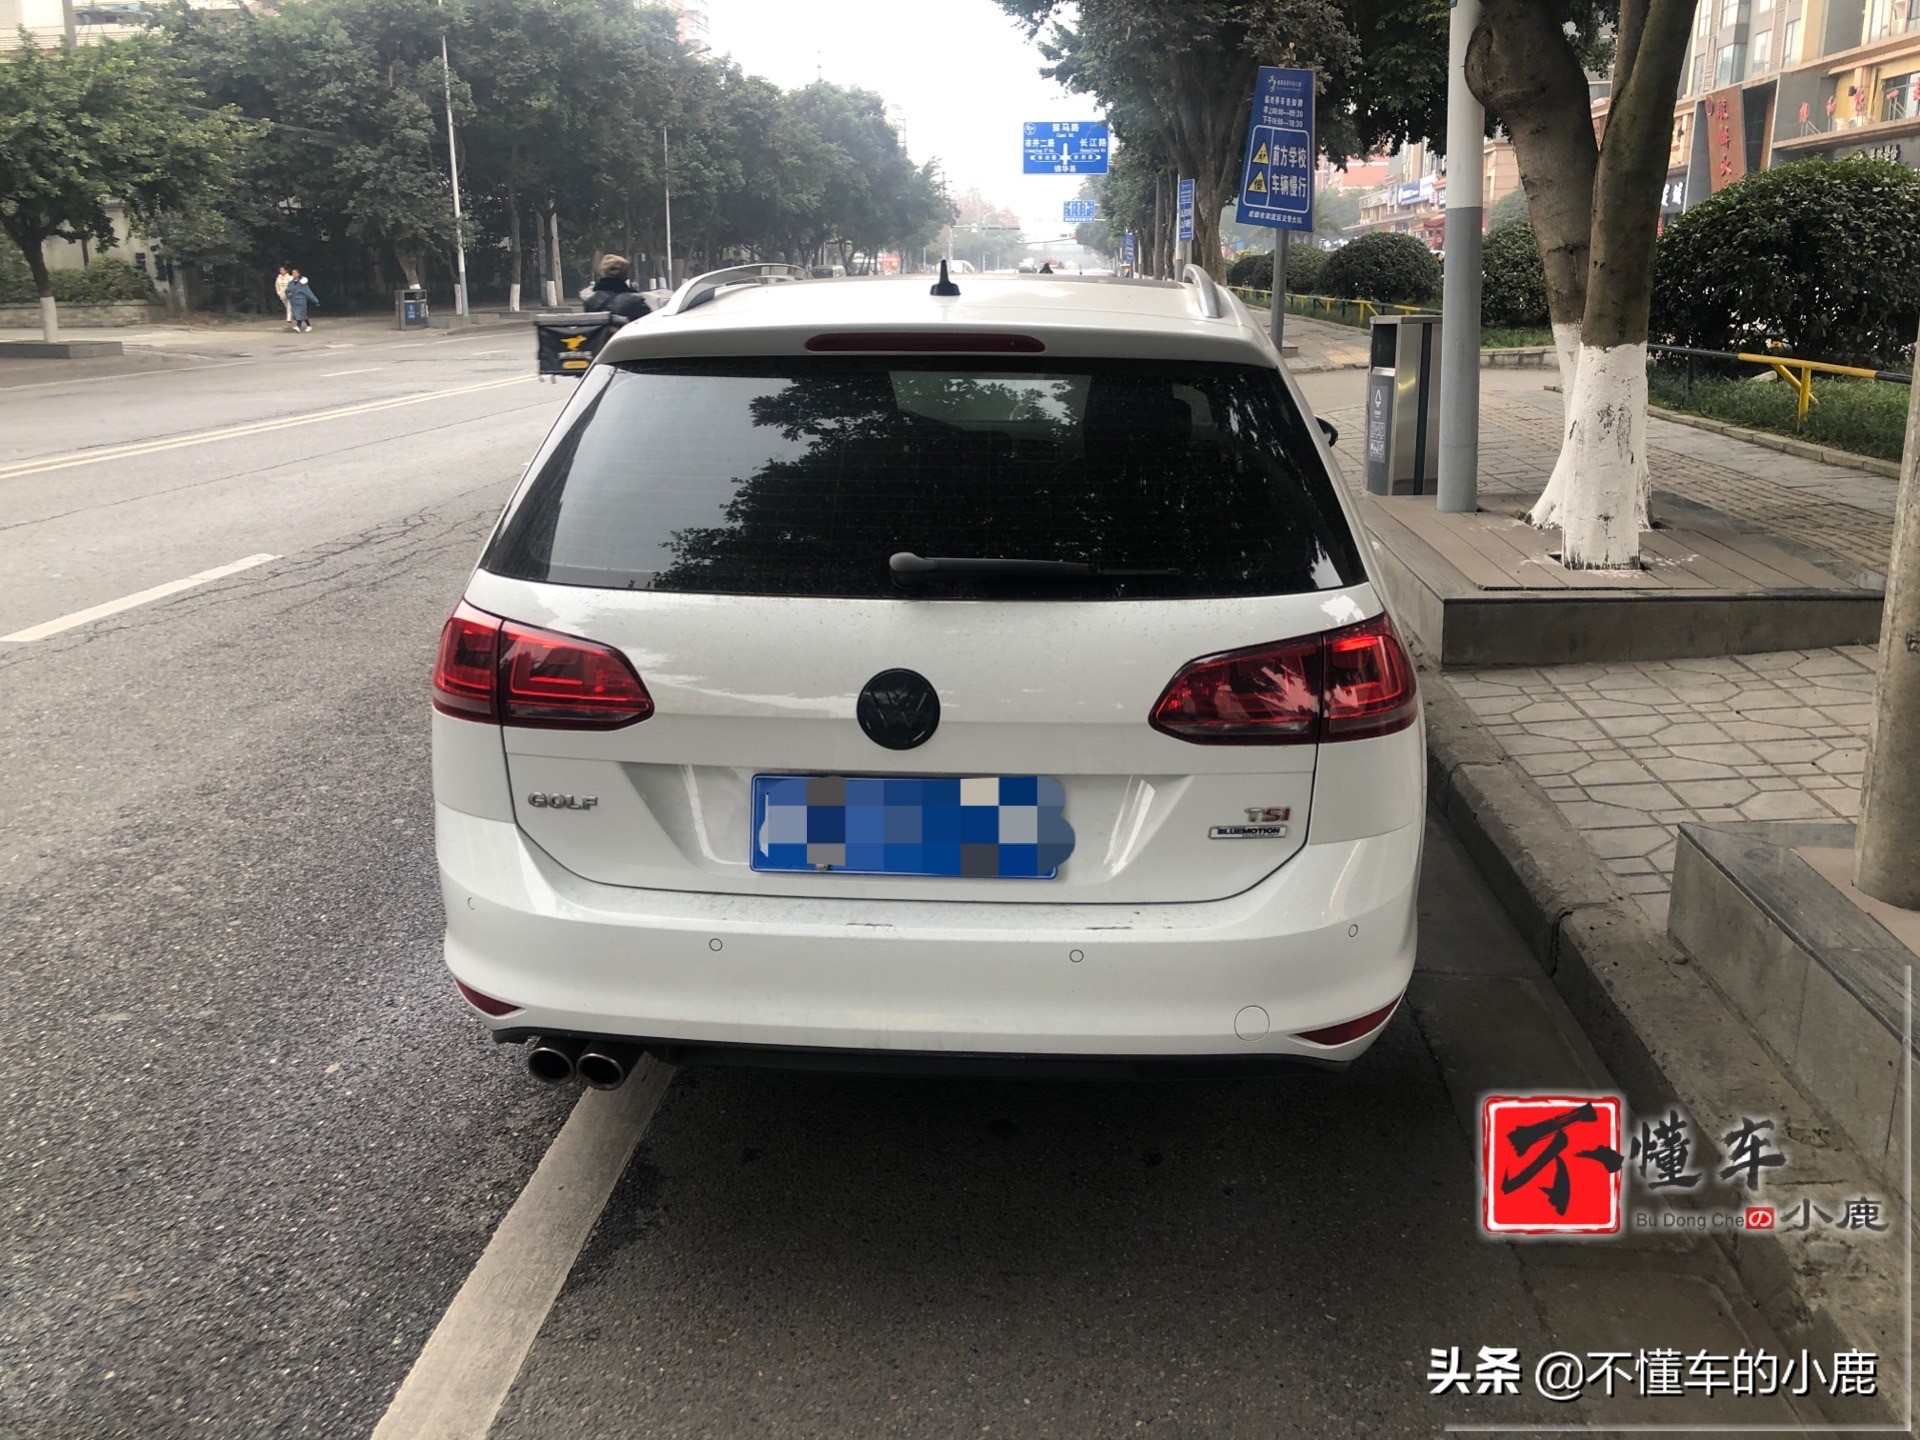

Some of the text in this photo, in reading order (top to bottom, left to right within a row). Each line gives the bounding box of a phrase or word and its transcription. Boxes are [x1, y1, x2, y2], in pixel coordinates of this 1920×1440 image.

[1079, 138, 1107, 147] 长江路
[1272, 144, 1307, 169] 前方学校
[1271, 173, 1307, 198] 车辆慢行
[527, 791, 598, 810] GOLF
[1244, 806, 1291, 823] TSI
[1217, 826, 1280, 835] BLUEMOTION
